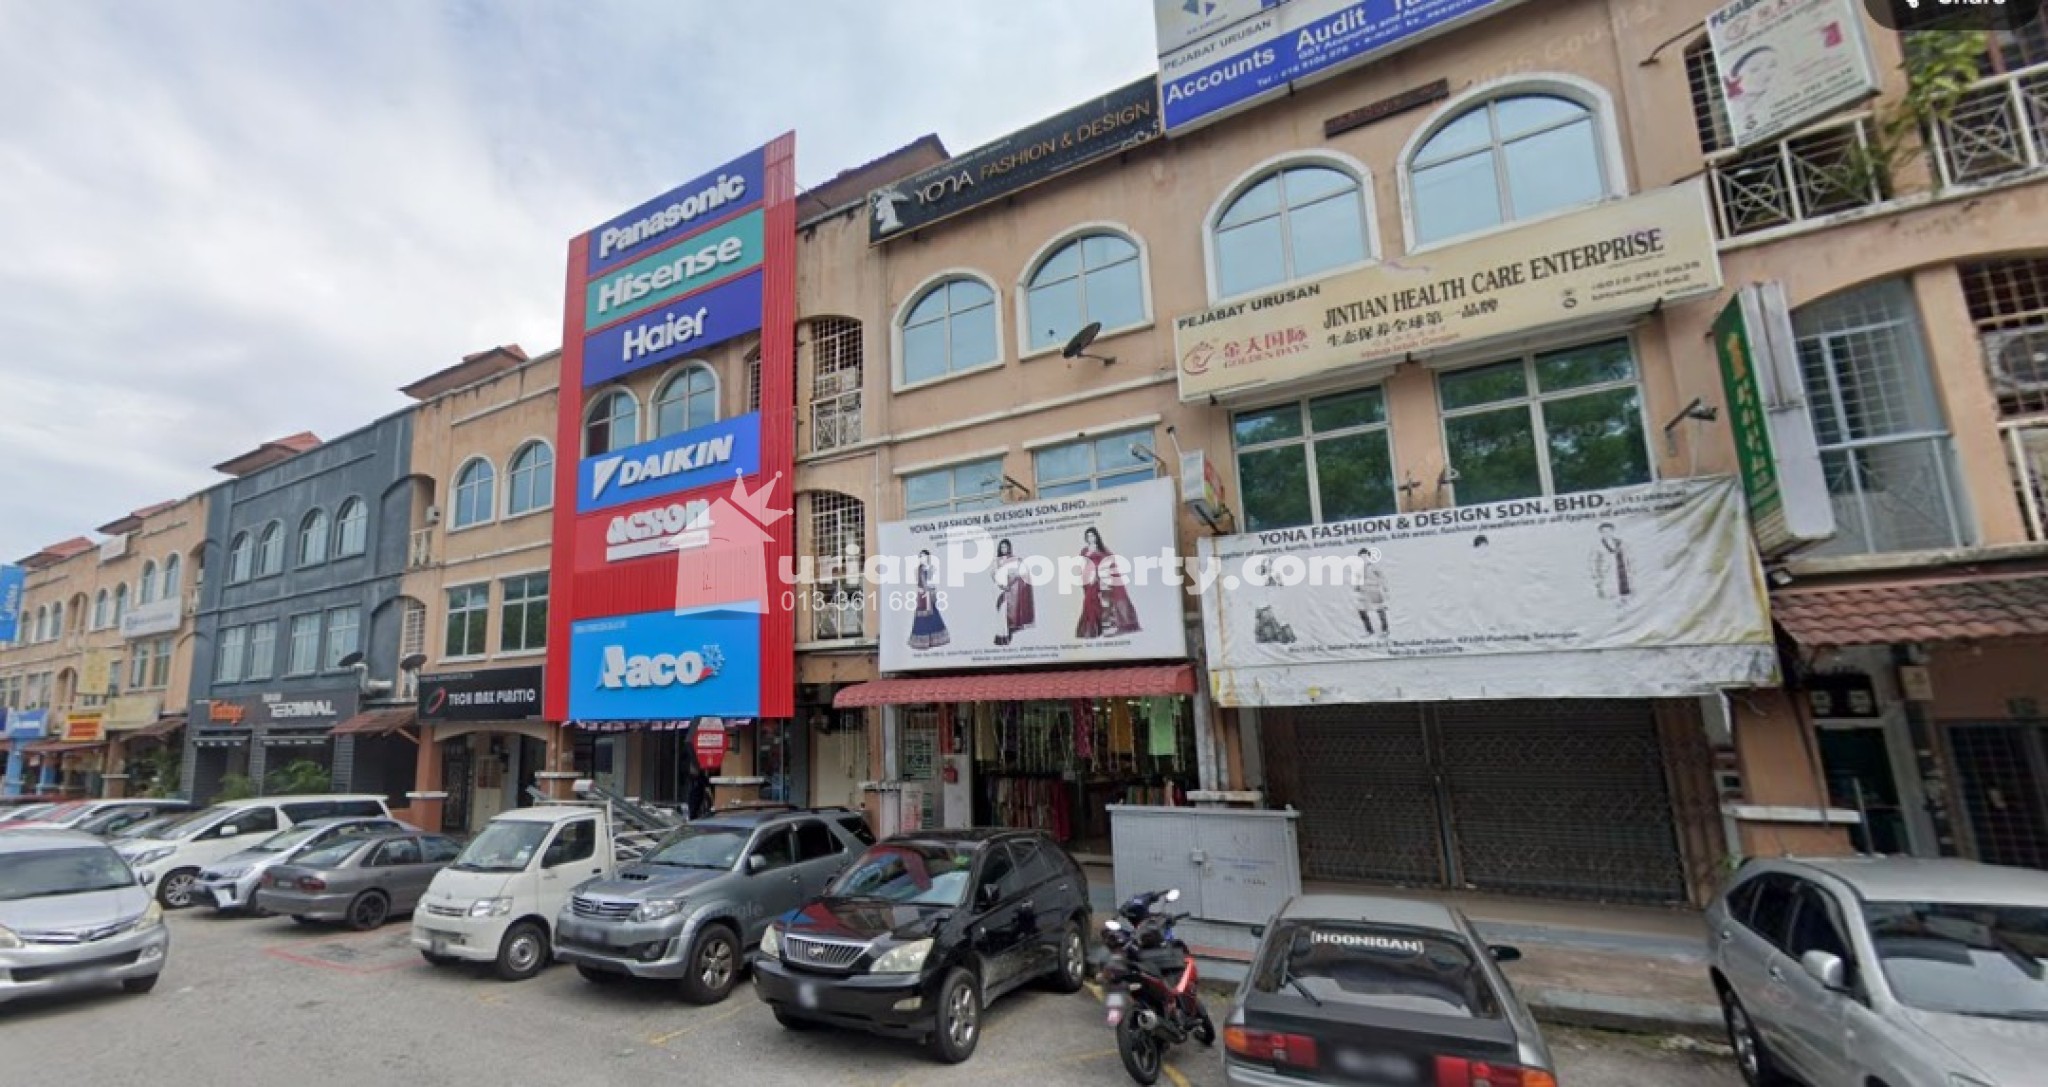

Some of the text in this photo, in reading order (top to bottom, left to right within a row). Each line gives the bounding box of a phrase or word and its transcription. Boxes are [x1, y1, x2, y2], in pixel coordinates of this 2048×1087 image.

[1163, 43, 1215, 72] PEJABAT
[1219, 19, 1272, 49] URUSAN
[1166, 48, 1276, 105] Accounts
[1297, 7, 1367, 51] Audit
[914, 170, 974, 206] YONA
[980, 137, 1056, 181] FASHION
[1060, 131, 1073, 149] &
[1076, 99, 1150, 144] DESIGN
[599, 173, 746, 260] Panasonic
[597, 236, 742, 313] Hisense
[1323, 295, 1389, 331] JINTIAN
[1392, 276, 1467, 312] HEALTH
[1471, 261, 1526, 294] CARE
[1529, 227, 1664, 281] ENTERPRISE
[623, 307, 708, 362] Haier
[1178, 283, 1321, 331] PEJABAT URUSAN
[618, 433, 734, 488] DAIKIN
[909, 521, 937, 535] YONA
[938, 515, 982, 532] FASHION
[983, 513, 992, 525] &
[993, 507, 1034, 525] DESIGN
[1258, 528, 1308, 546] YONA
[1311, 518, 1391, 540] FASHION
[1396, 516, 1410, 529] &
[1415, 505, 1491, 527] DESIGN
[1497, 500, 1549, 519] SDN.
[1554, 493, 1611, 513] BHD.
